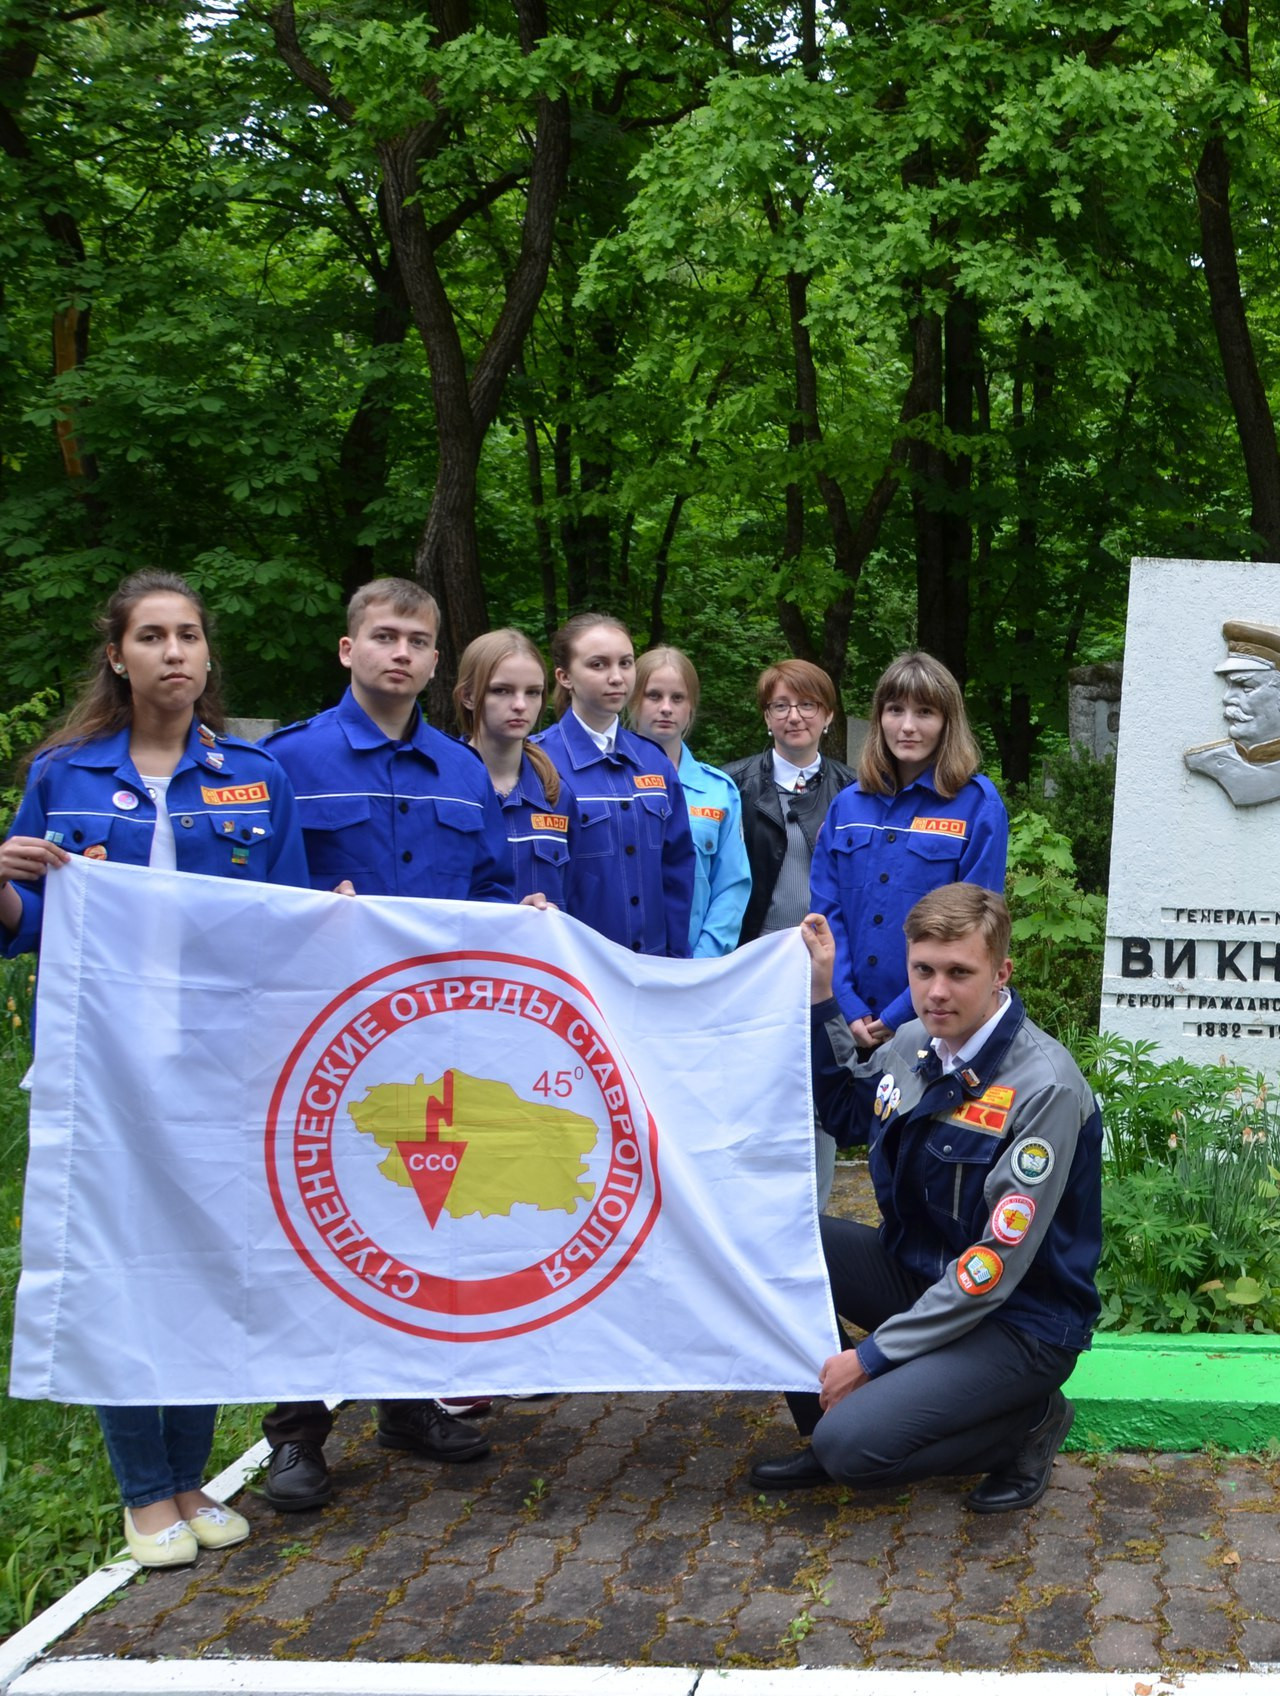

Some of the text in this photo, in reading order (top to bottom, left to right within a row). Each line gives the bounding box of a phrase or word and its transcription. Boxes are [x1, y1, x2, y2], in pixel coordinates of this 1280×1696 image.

[298, 980, 640, 1298] СТУДЕНЧЕСКИЕ ОТРЯДЫ СТАВРОПОЛЬЯ
[409, 1153, 457, 1171] ССО
